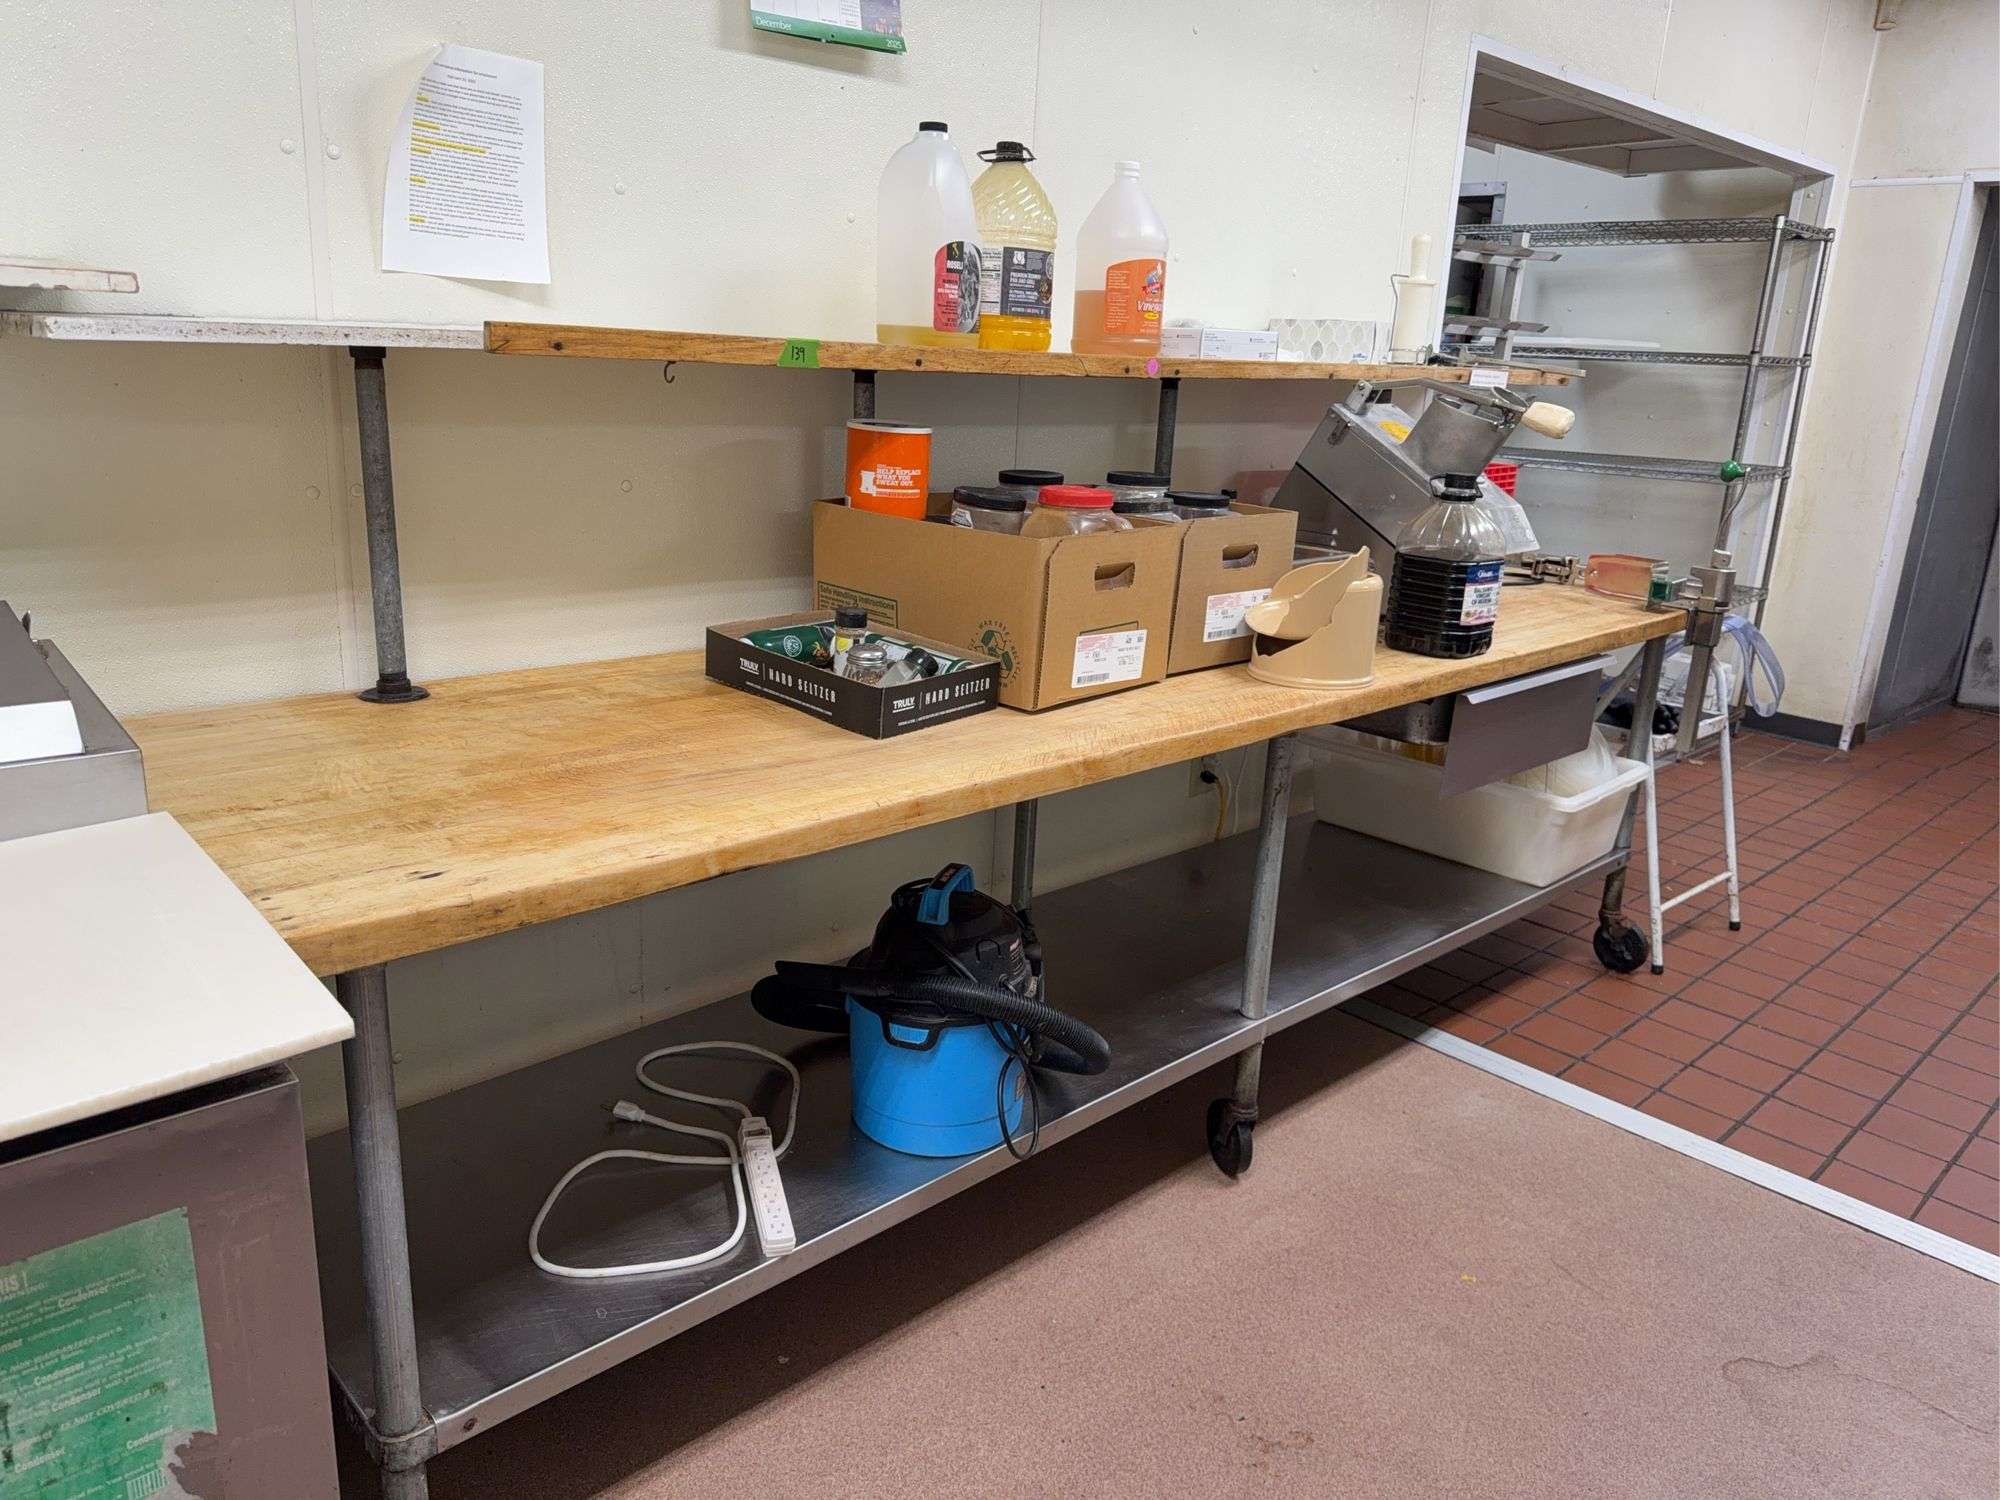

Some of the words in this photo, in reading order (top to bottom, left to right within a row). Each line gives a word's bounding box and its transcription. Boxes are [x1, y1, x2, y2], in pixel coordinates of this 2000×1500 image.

[755, 15, 792, 31] December
[791, 345, 806, 364] 139
[740, 657, 759, 671] TRULY
[768, 668, 793, 687] HARD
[798, 678, 836, 703] SELTZER
[893, 696, 915, 709] TRULY
[925, 687, 950, 705] HARD
[954, 677, 990, 698] SELTZER
[127, 1425, 175, 1450] Condenser
[15, 1446, 66, 1474] Condenser
